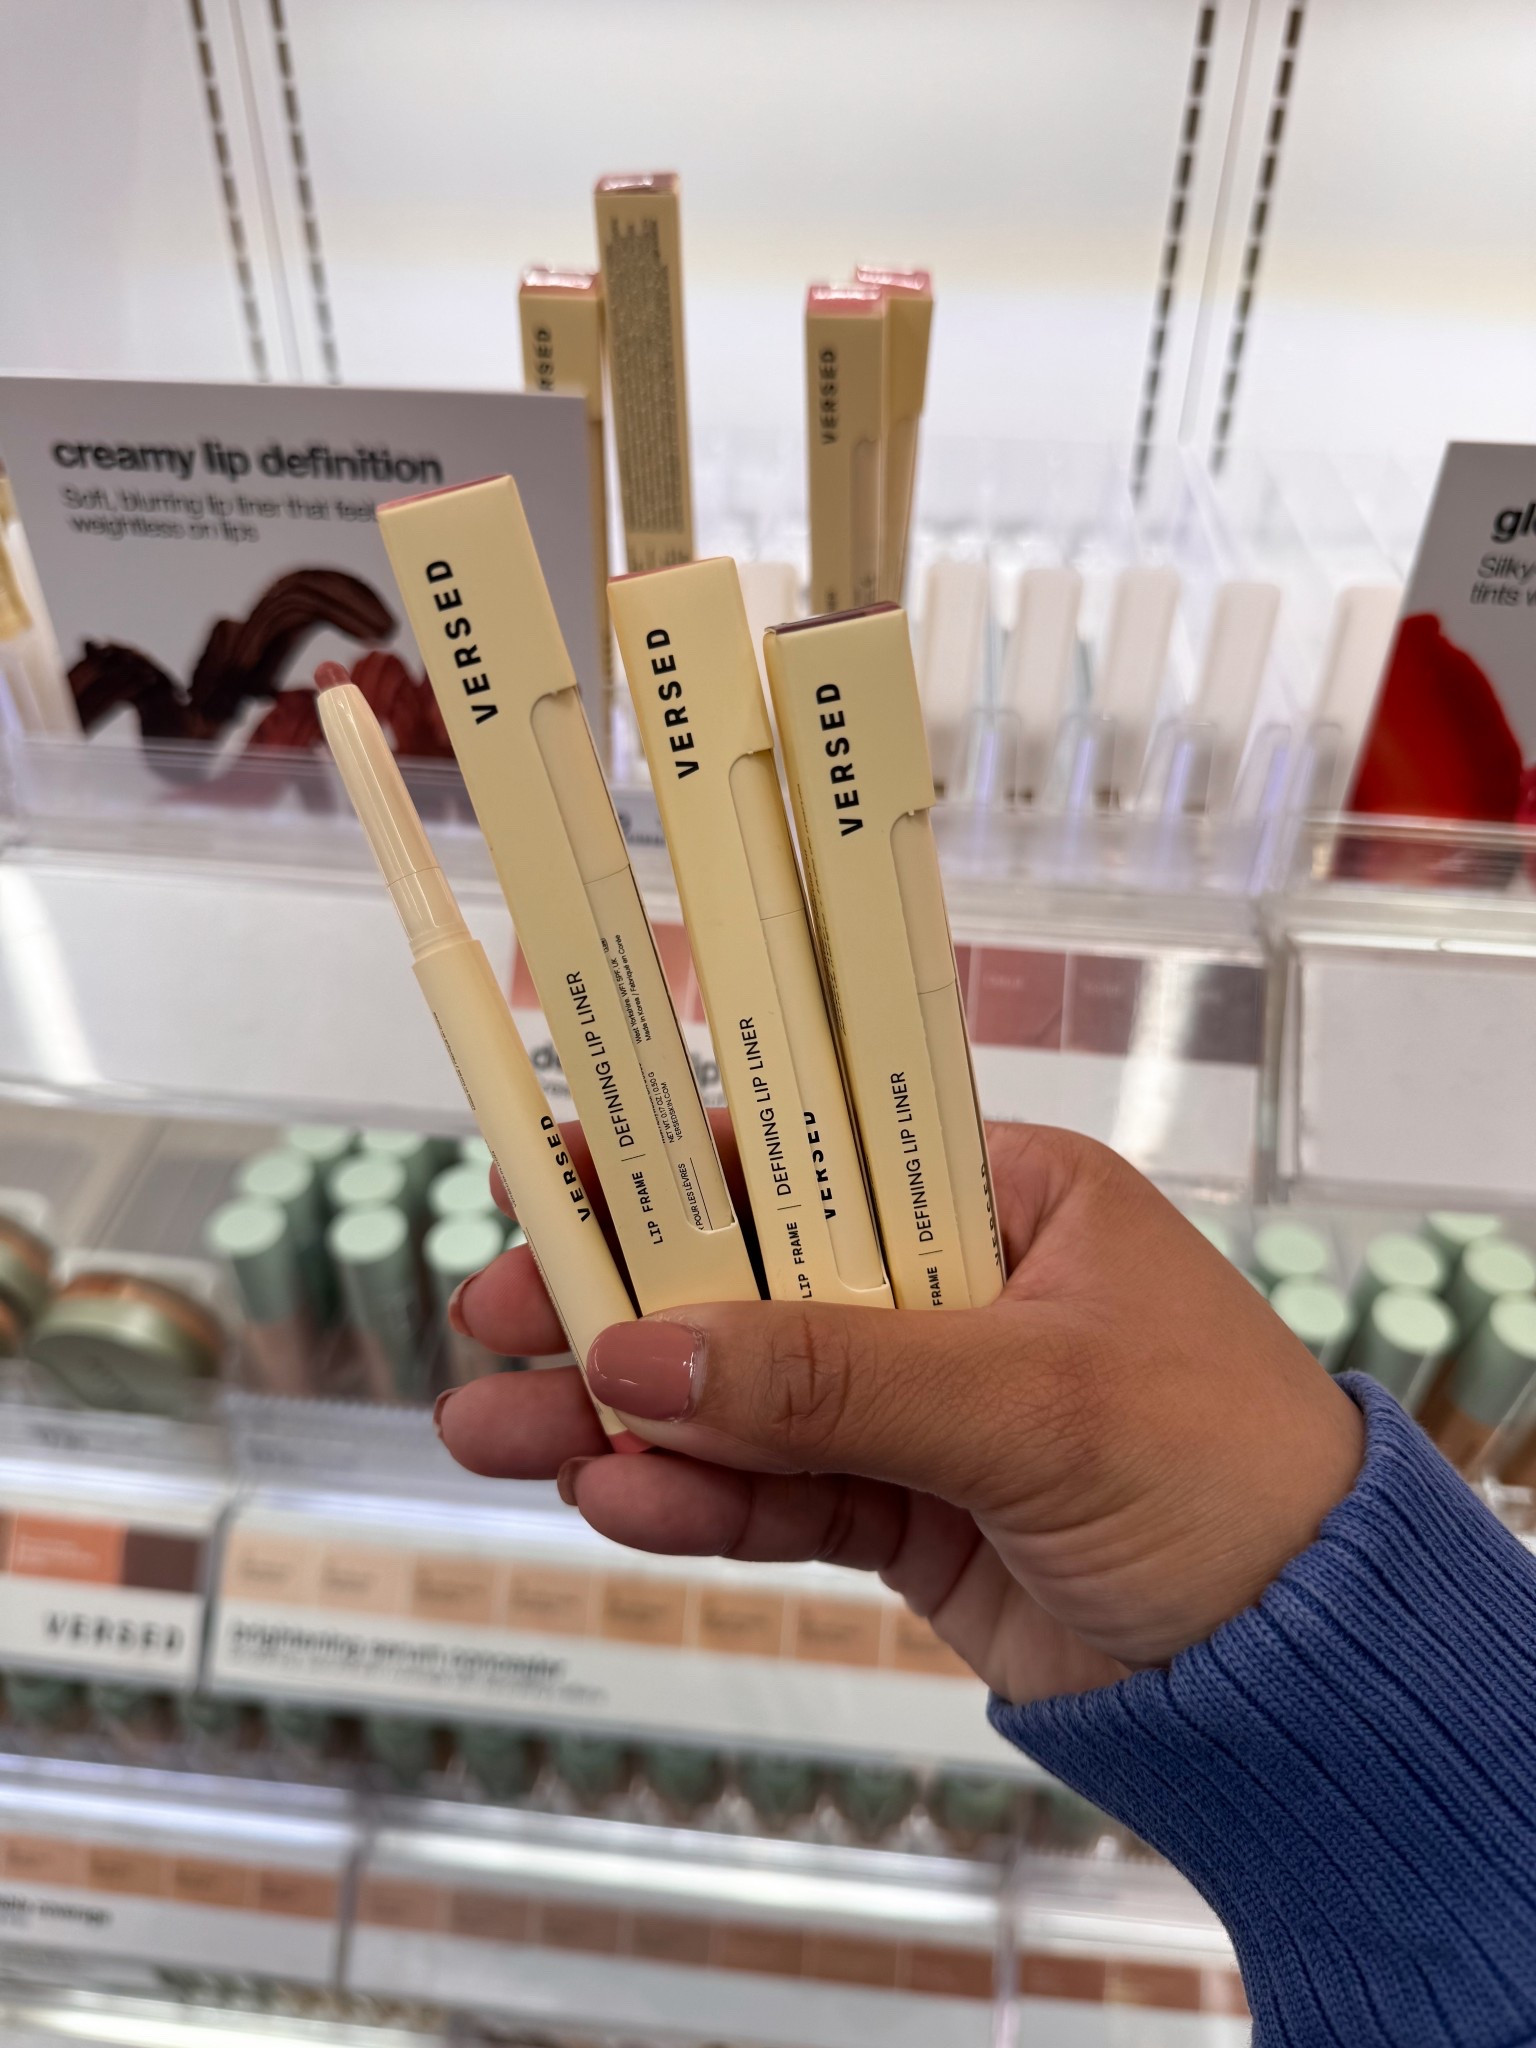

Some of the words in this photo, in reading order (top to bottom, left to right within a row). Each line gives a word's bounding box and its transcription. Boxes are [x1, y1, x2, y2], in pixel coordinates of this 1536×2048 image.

[819, 348, 838, 446] VERSED
[52, 441, 195, 481] creamy
[203, 440, 252, 482] lip
[259, 445, 443, 484] definition
[122, 487, 205, 520] blurring
[209, 490, 234, 519] lip
[237, 494, 281, 519] liner
[287, 496, 329, 522] that
[1490, 501, 1536, 545] gl
[70, 515, 185, 542] weightless
[189, 522, 217, 541] on
[222, 519, 260, 545] lips
[1470, 582, 1520, 607] tints
[426, 560, 498, 725] VERSED
[646, 629, 699, 779] VERSED
[816, 683, 863, 836] VERSED
[566, 970, 596, 1025] LINER
[585, 1030, 606, 1057] LIP
[643, 1023, 652, 1041] Made
[739, 1016, 764, 1071] LINER
[595, 1062, 635, 1148] DEFINING
[752, 1076, 771, 1103] LIP
[890, 1071, 913, 1123] LINER
[759, 1107, 791, 1196] DEFINING
[900, 1128, 918, 1154] LIP
[540, 1114, 591, 1222] VERSED
[631, 1170, 654, 1213] FRAME
[687, 1191, 696, 1204] LES
[906, 1158, 934, 1243] DEFINING
[647, 1220, 664, 1246] LIP
[691, 1205, 703, 1226] POUR
[786, 1221, 805, 1265] FRAME
[798, 1273, 813, 1299] LIP
[926, 1266, 943, 1306] FRAME
